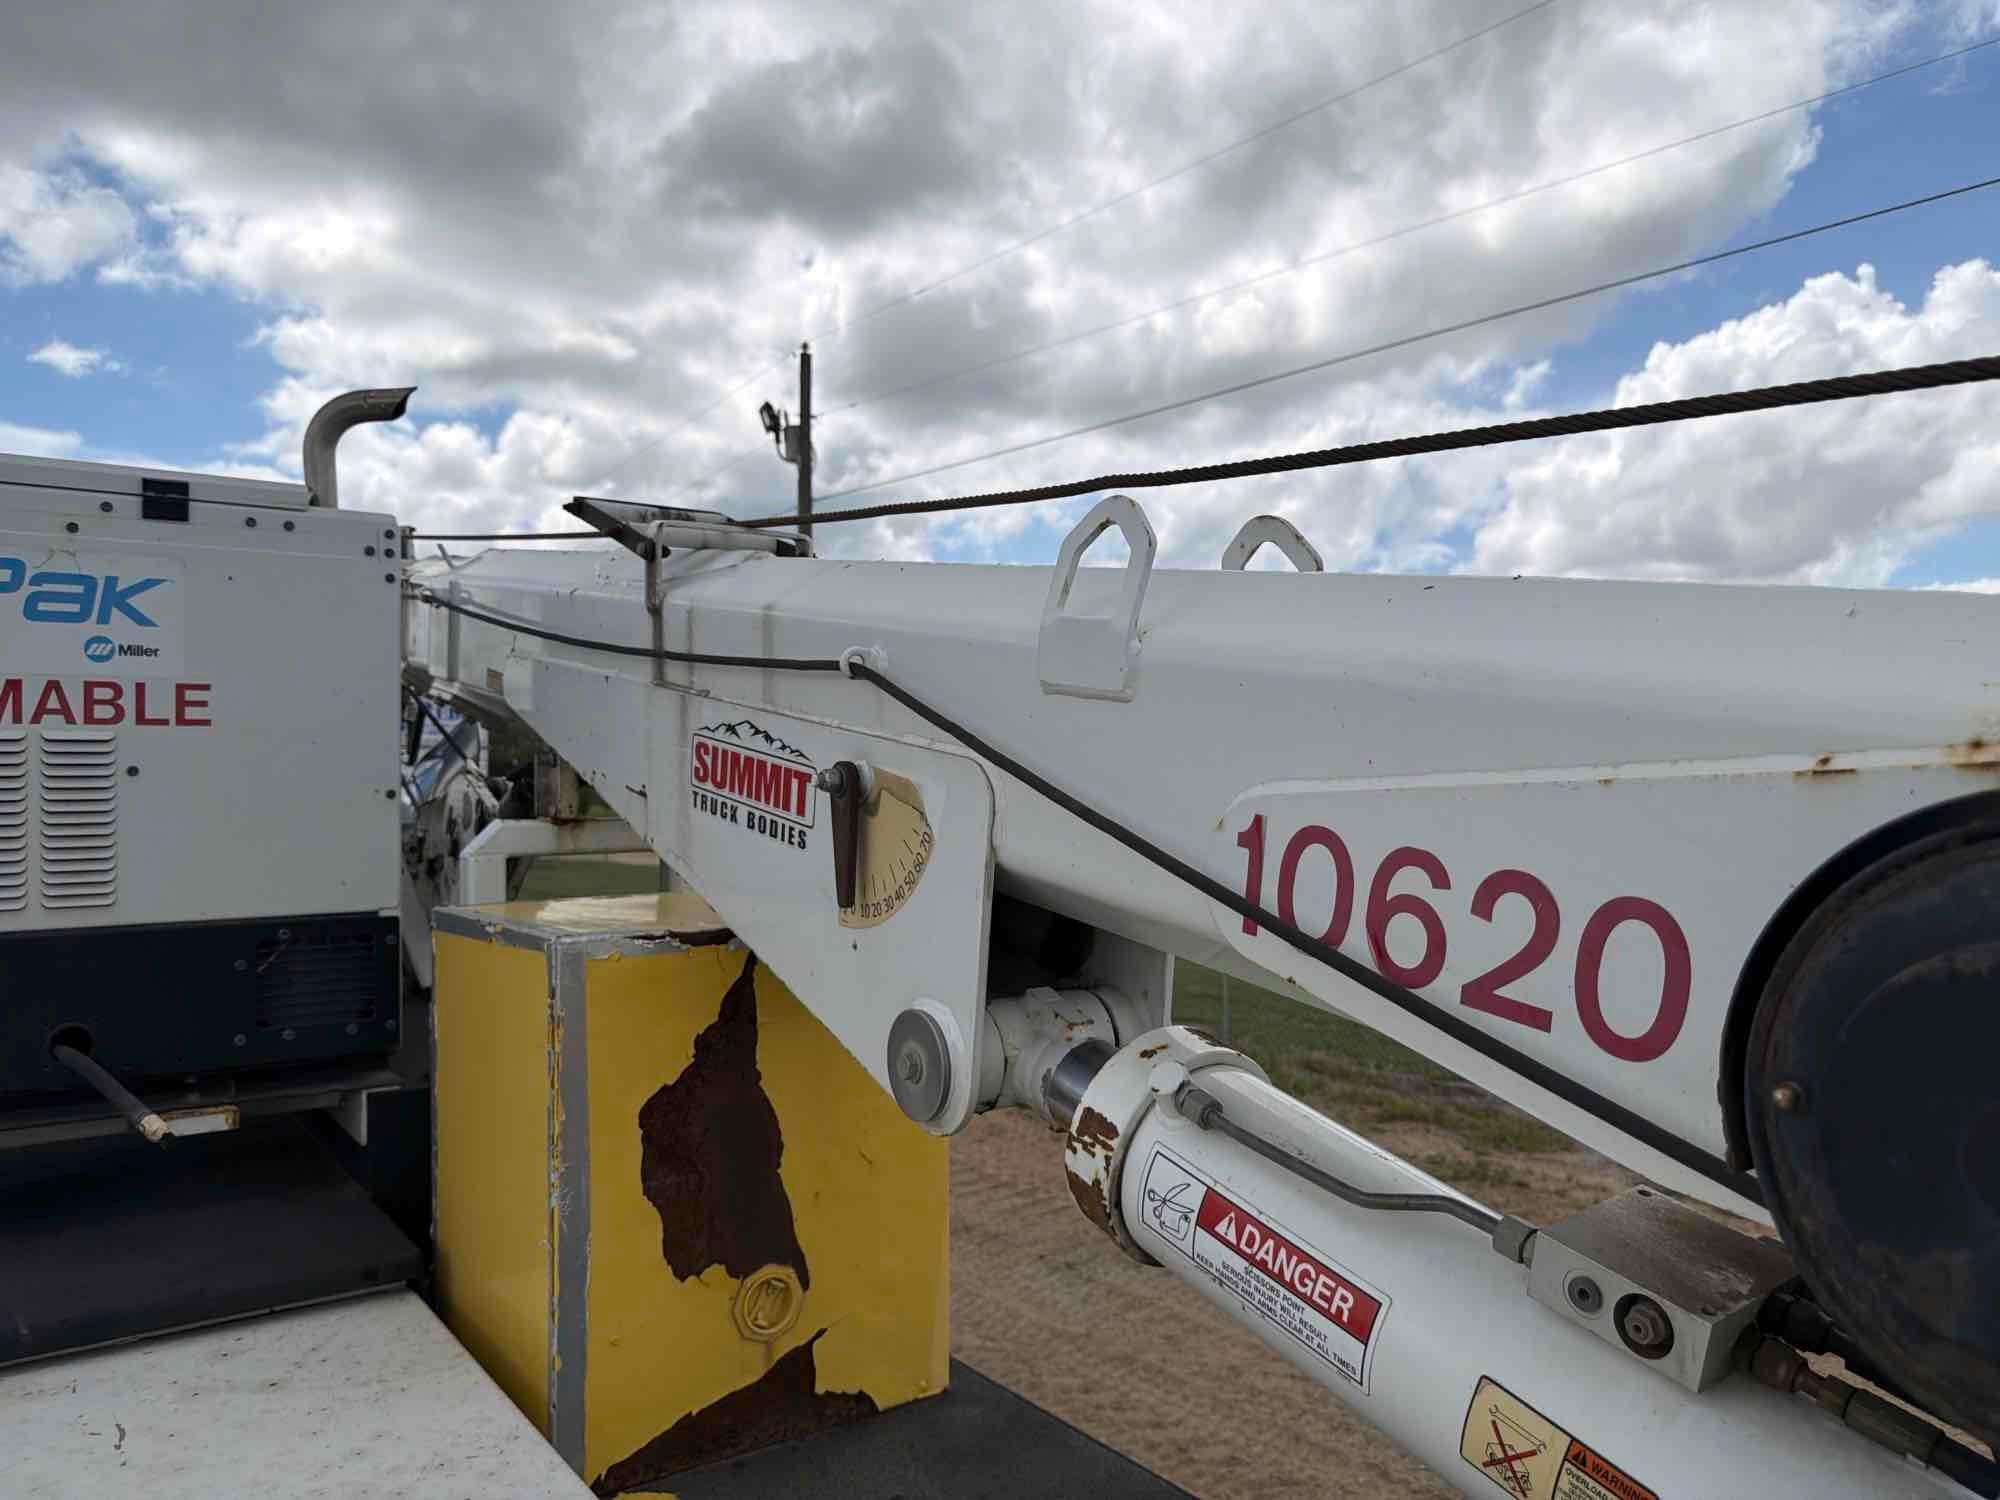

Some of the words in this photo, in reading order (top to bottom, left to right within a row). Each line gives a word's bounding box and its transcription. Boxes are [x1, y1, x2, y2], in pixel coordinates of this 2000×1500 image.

[118, 644, 160, 657] Miller
[694, 741, 812, 818] SUMMIT
[692, 790, 738, 825] TRUCK
[747, 811, 807, 850] BODIES
[860, 903, 870, 918] 10
[872, 902, 882, 918] 20
[883, 896, 895, 913] 30
[895, 885, 906, 902] 40
[904, 870, 916, 893] 50
[913, 852, 925, 873] 60
[920, 832, 933, 853] 70
[1237, 814, 1692, 1062] 10620
[1239, 1223, 1354, 1323] DANGER
[1244, 1266, 1280, 1298] SCISSORS
[1282, 1294, 1305, 1315] POINT
[1241, 1286, 1256, 1301] AND
[1280, 1313, 1304, 1335] CLEAR
[1316, 1342, 1329, 1356] ALL
[1332, 1351, 1356, 1376] TIMES
[1253, 1283, 1278, 1306] INJURY
[1280, 1301, 1296, 1321] WILL
[1299, 1317, 1327, 1342] RESULT
